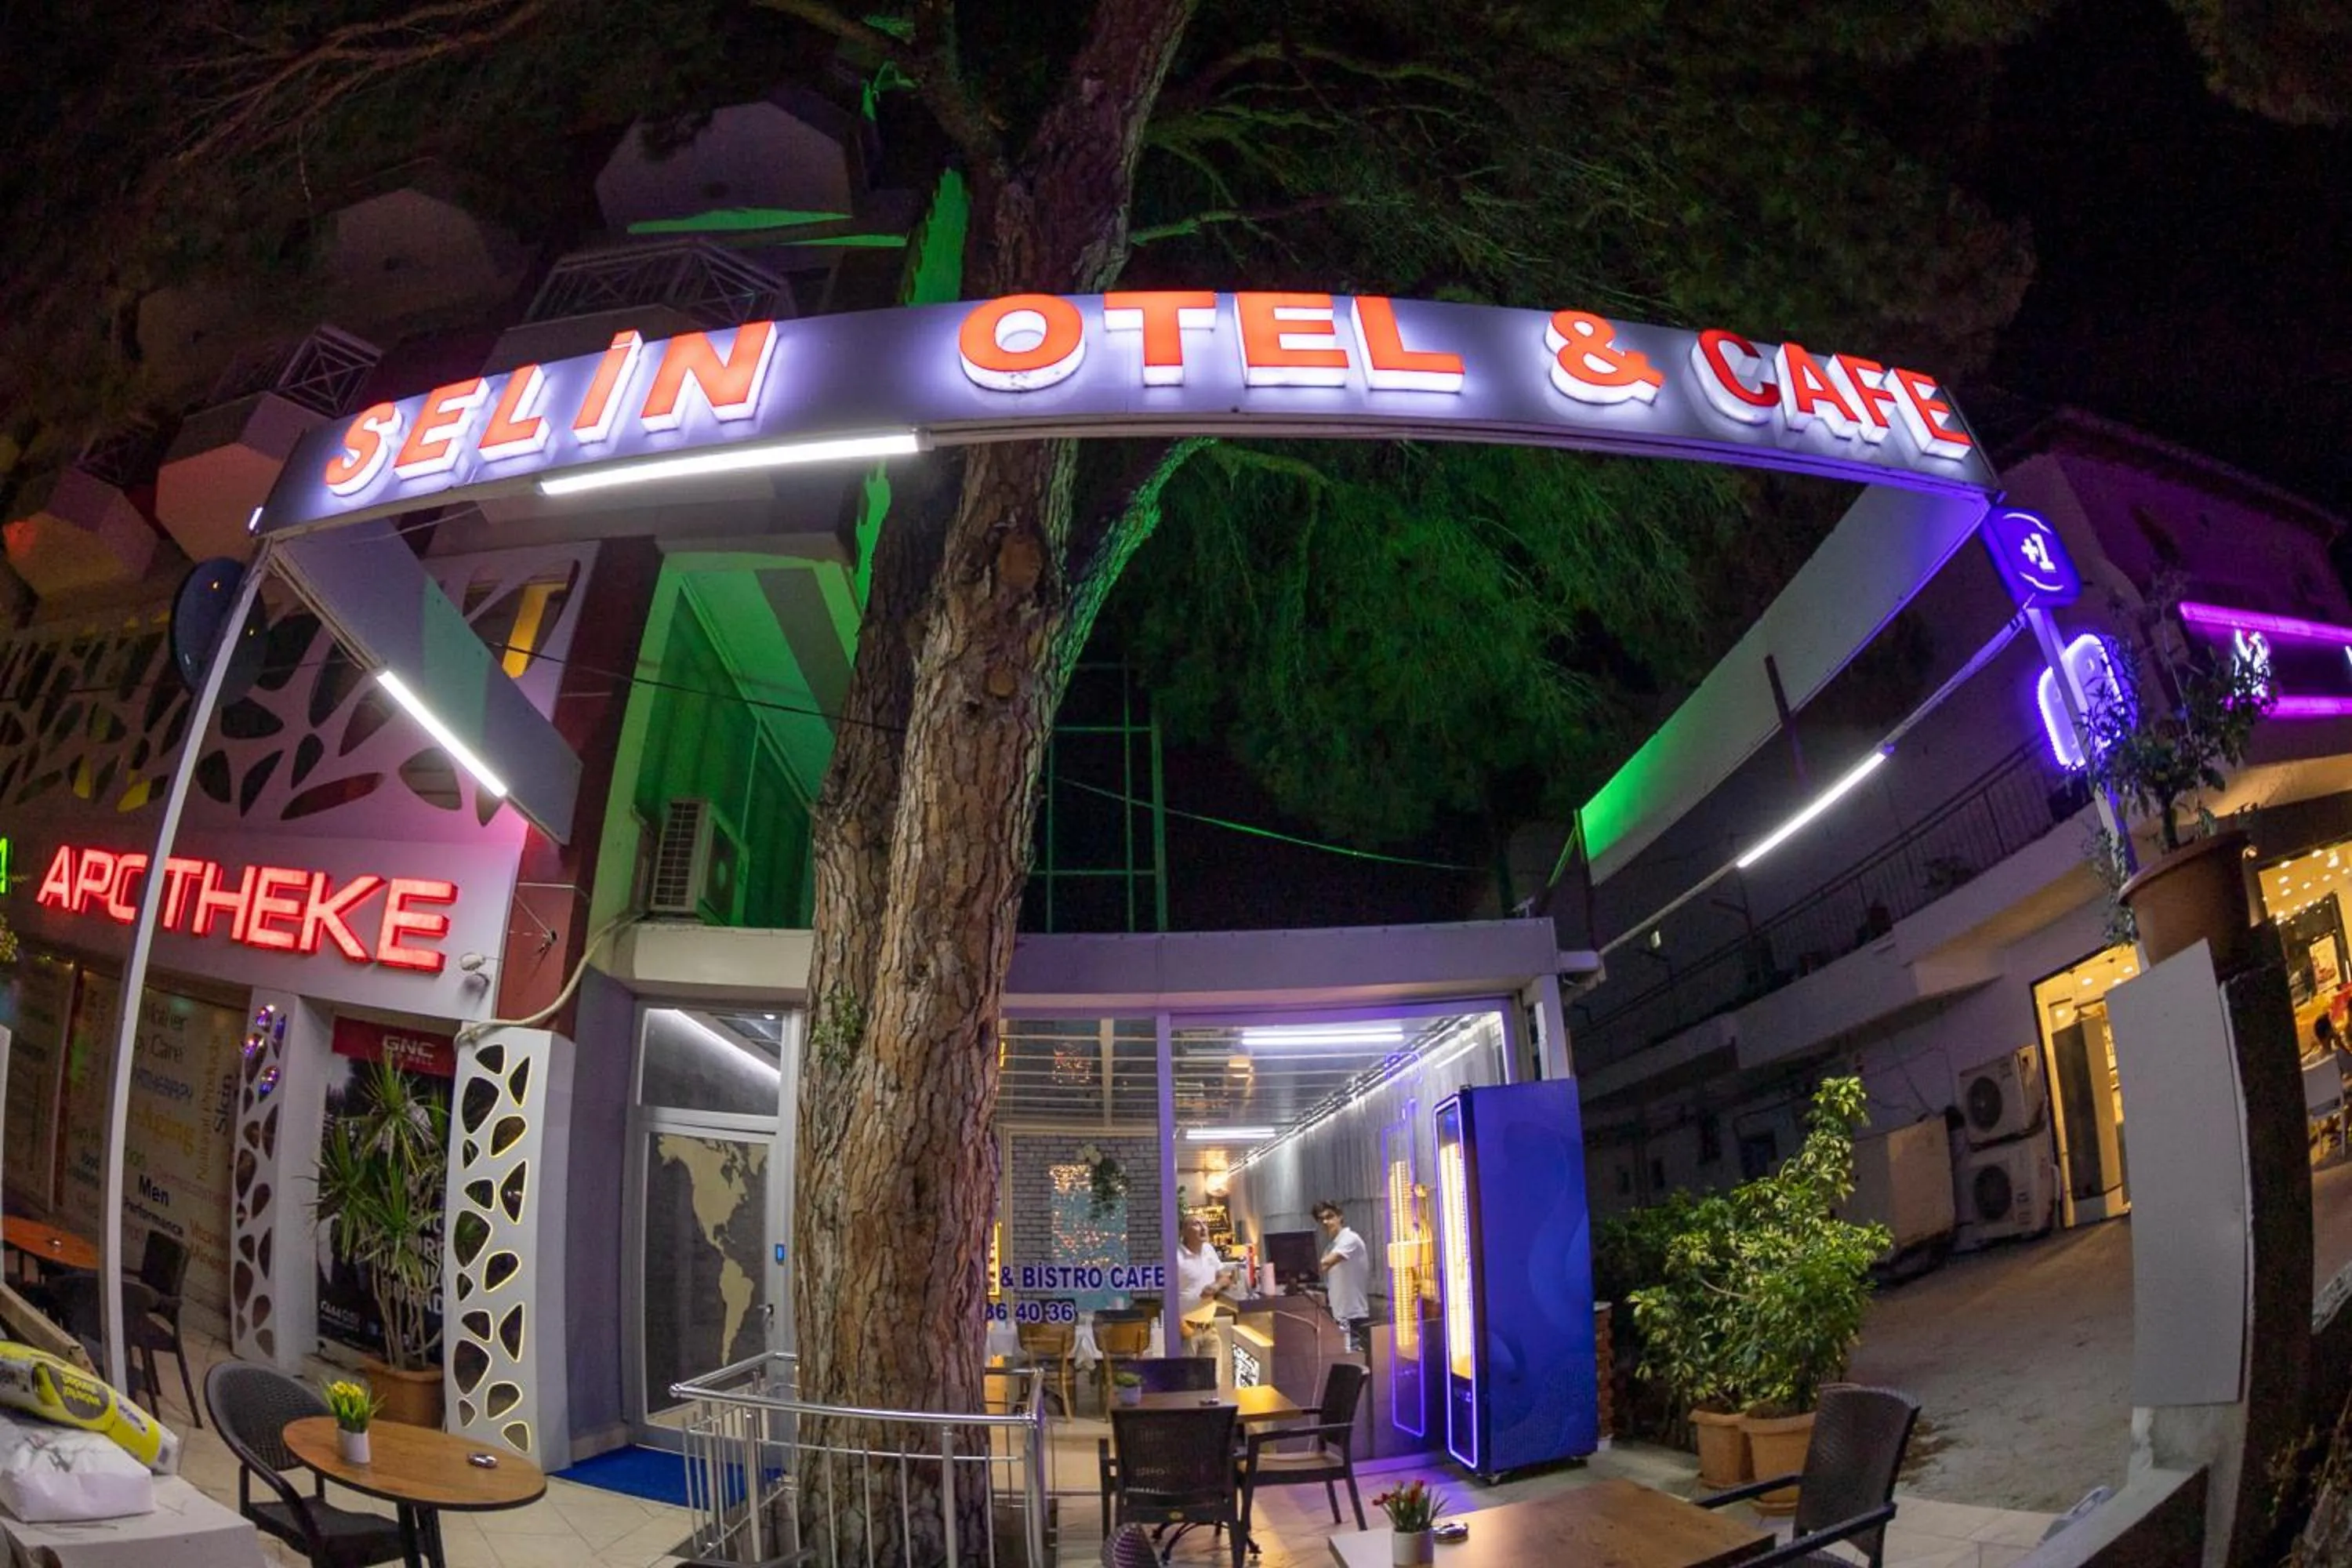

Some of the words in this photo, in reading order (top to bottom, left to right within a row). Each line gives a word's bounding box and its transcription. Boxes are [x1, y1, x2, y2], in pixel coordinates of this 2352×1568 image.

[324, 320, 779, 495] SELİN
[959, 291, 1465, 394] OTEL
[1544, 310, 1664, 405] &
[1691, 328, 1971, 460] CAFE
[383, 1034, 436, 1059] GNC
[138, 1174, 170, 1207] Men
[1000, 1265, 1014, 1287] &
[1110, 1265, 1165, 1288] CAFE
[1015, 1302, 1040, 1322] 40
[1047, 1303, 1074, 1322] 36
